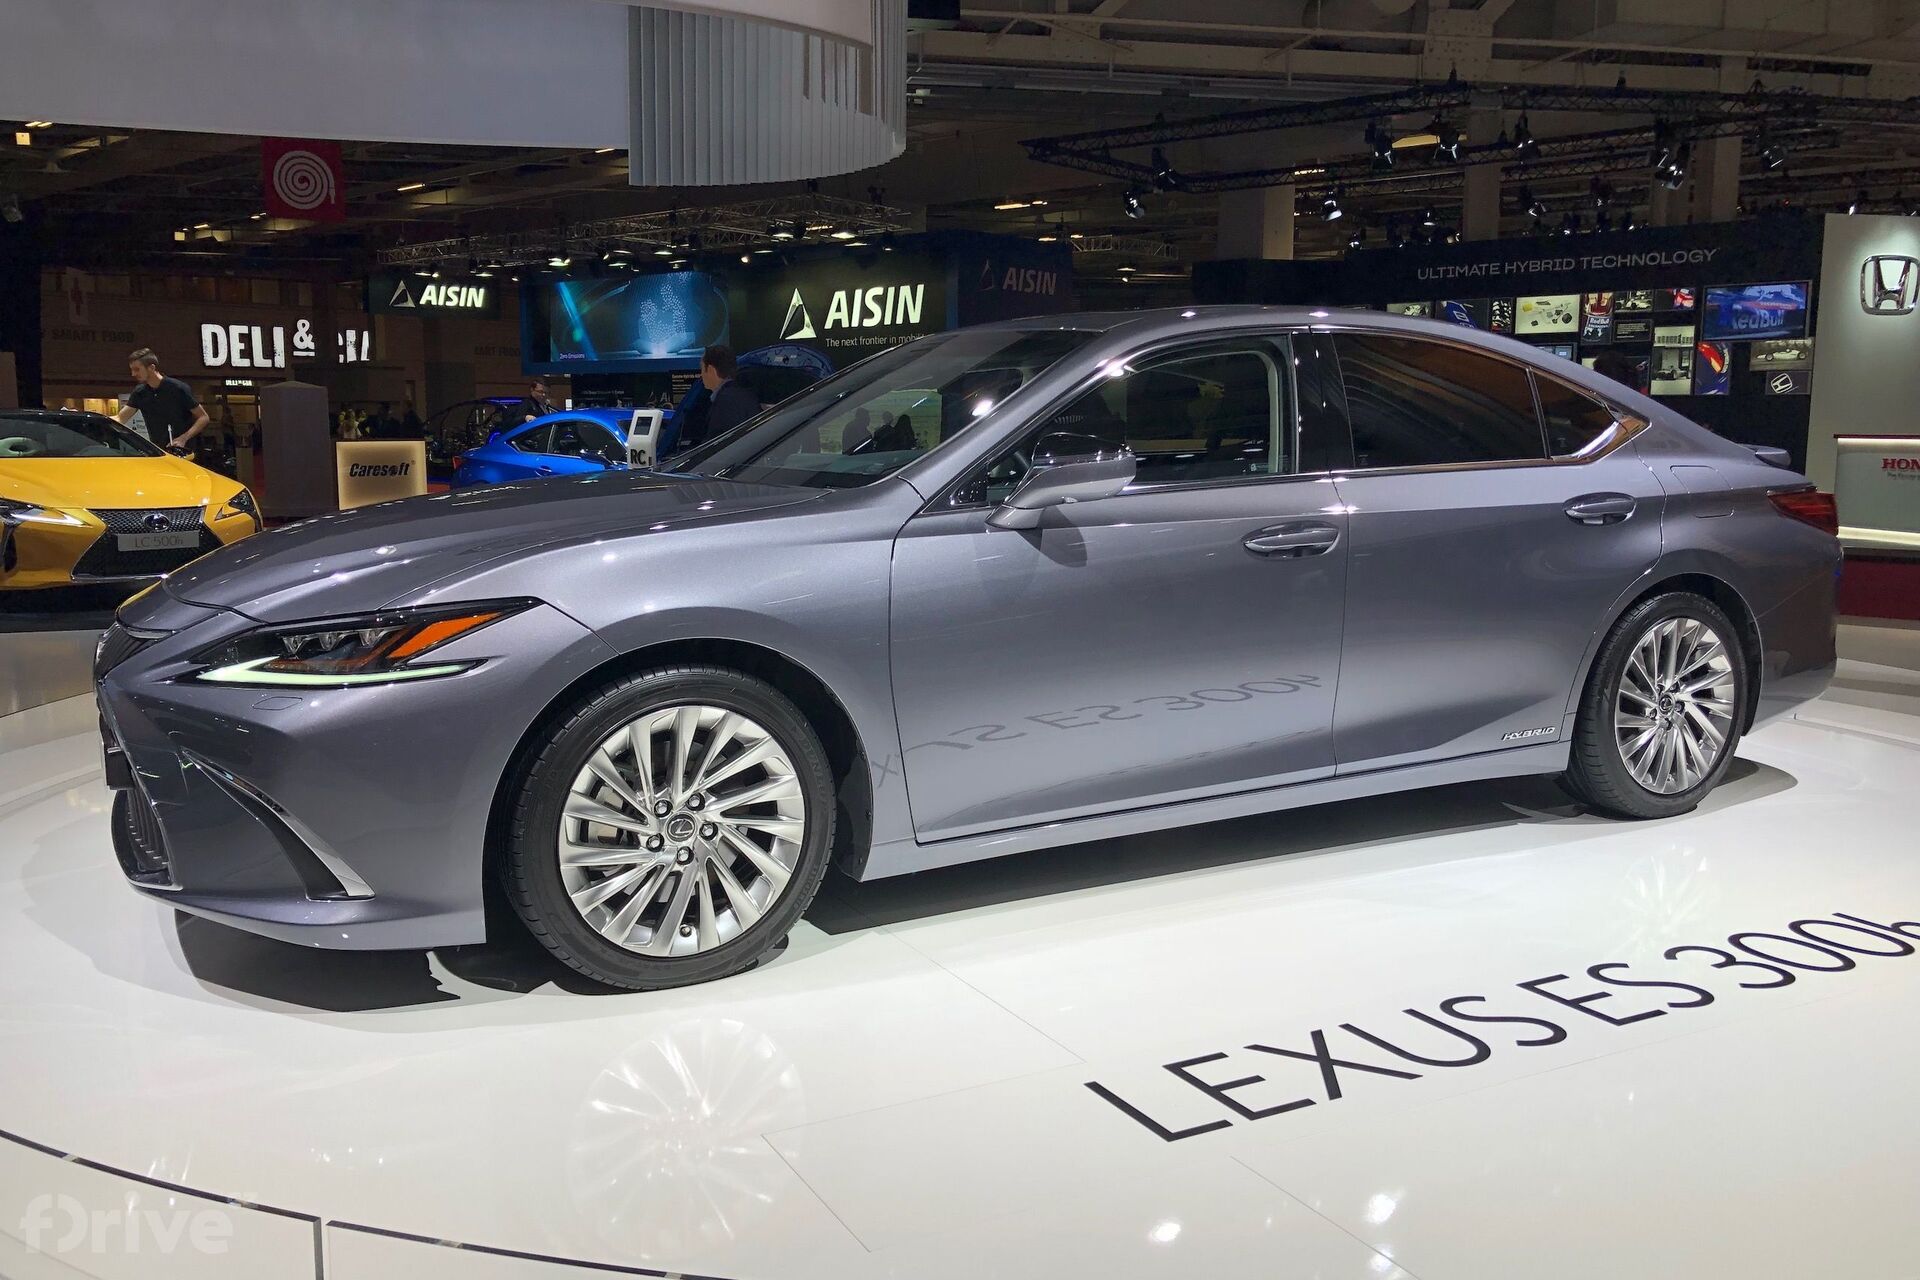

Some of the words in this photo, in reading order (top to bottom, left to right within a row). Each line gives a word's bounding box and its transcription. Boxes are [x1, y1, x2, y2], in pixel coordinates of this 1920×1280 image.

[1417, 263, 1500, 281] ULTIMATE
[1504, 257, 1576, 275] HYBRID
[1580, 248, 1719, 271] TECHNOLOGY
[1002, 266, 1057, 296] AISIN
[418, 284, 486, 308] AISIN
[823, 283, 926, 331] AISIN
[200, 322, 286, 369] DELI
[292, 318, 316, 357] &
[825, 337, 840, 348] The
[841, 337, 858, 347] next
[859, 334, 887, 346] frontier
[889, 334, 898, 344] in
[629, 448, 647, 466] RC
[349, 462, 411, 478] Caresoft
[135, 538, 151, 549] LC
[153, 534, 184, 547] 500h
[1501, 726, 1557, 742] HYBRID
[1084, 995, 1568, 1143] LEXUS
[1517, 962, 1715, 1027] ES
[1664, 911, 1920, 989] 300h
